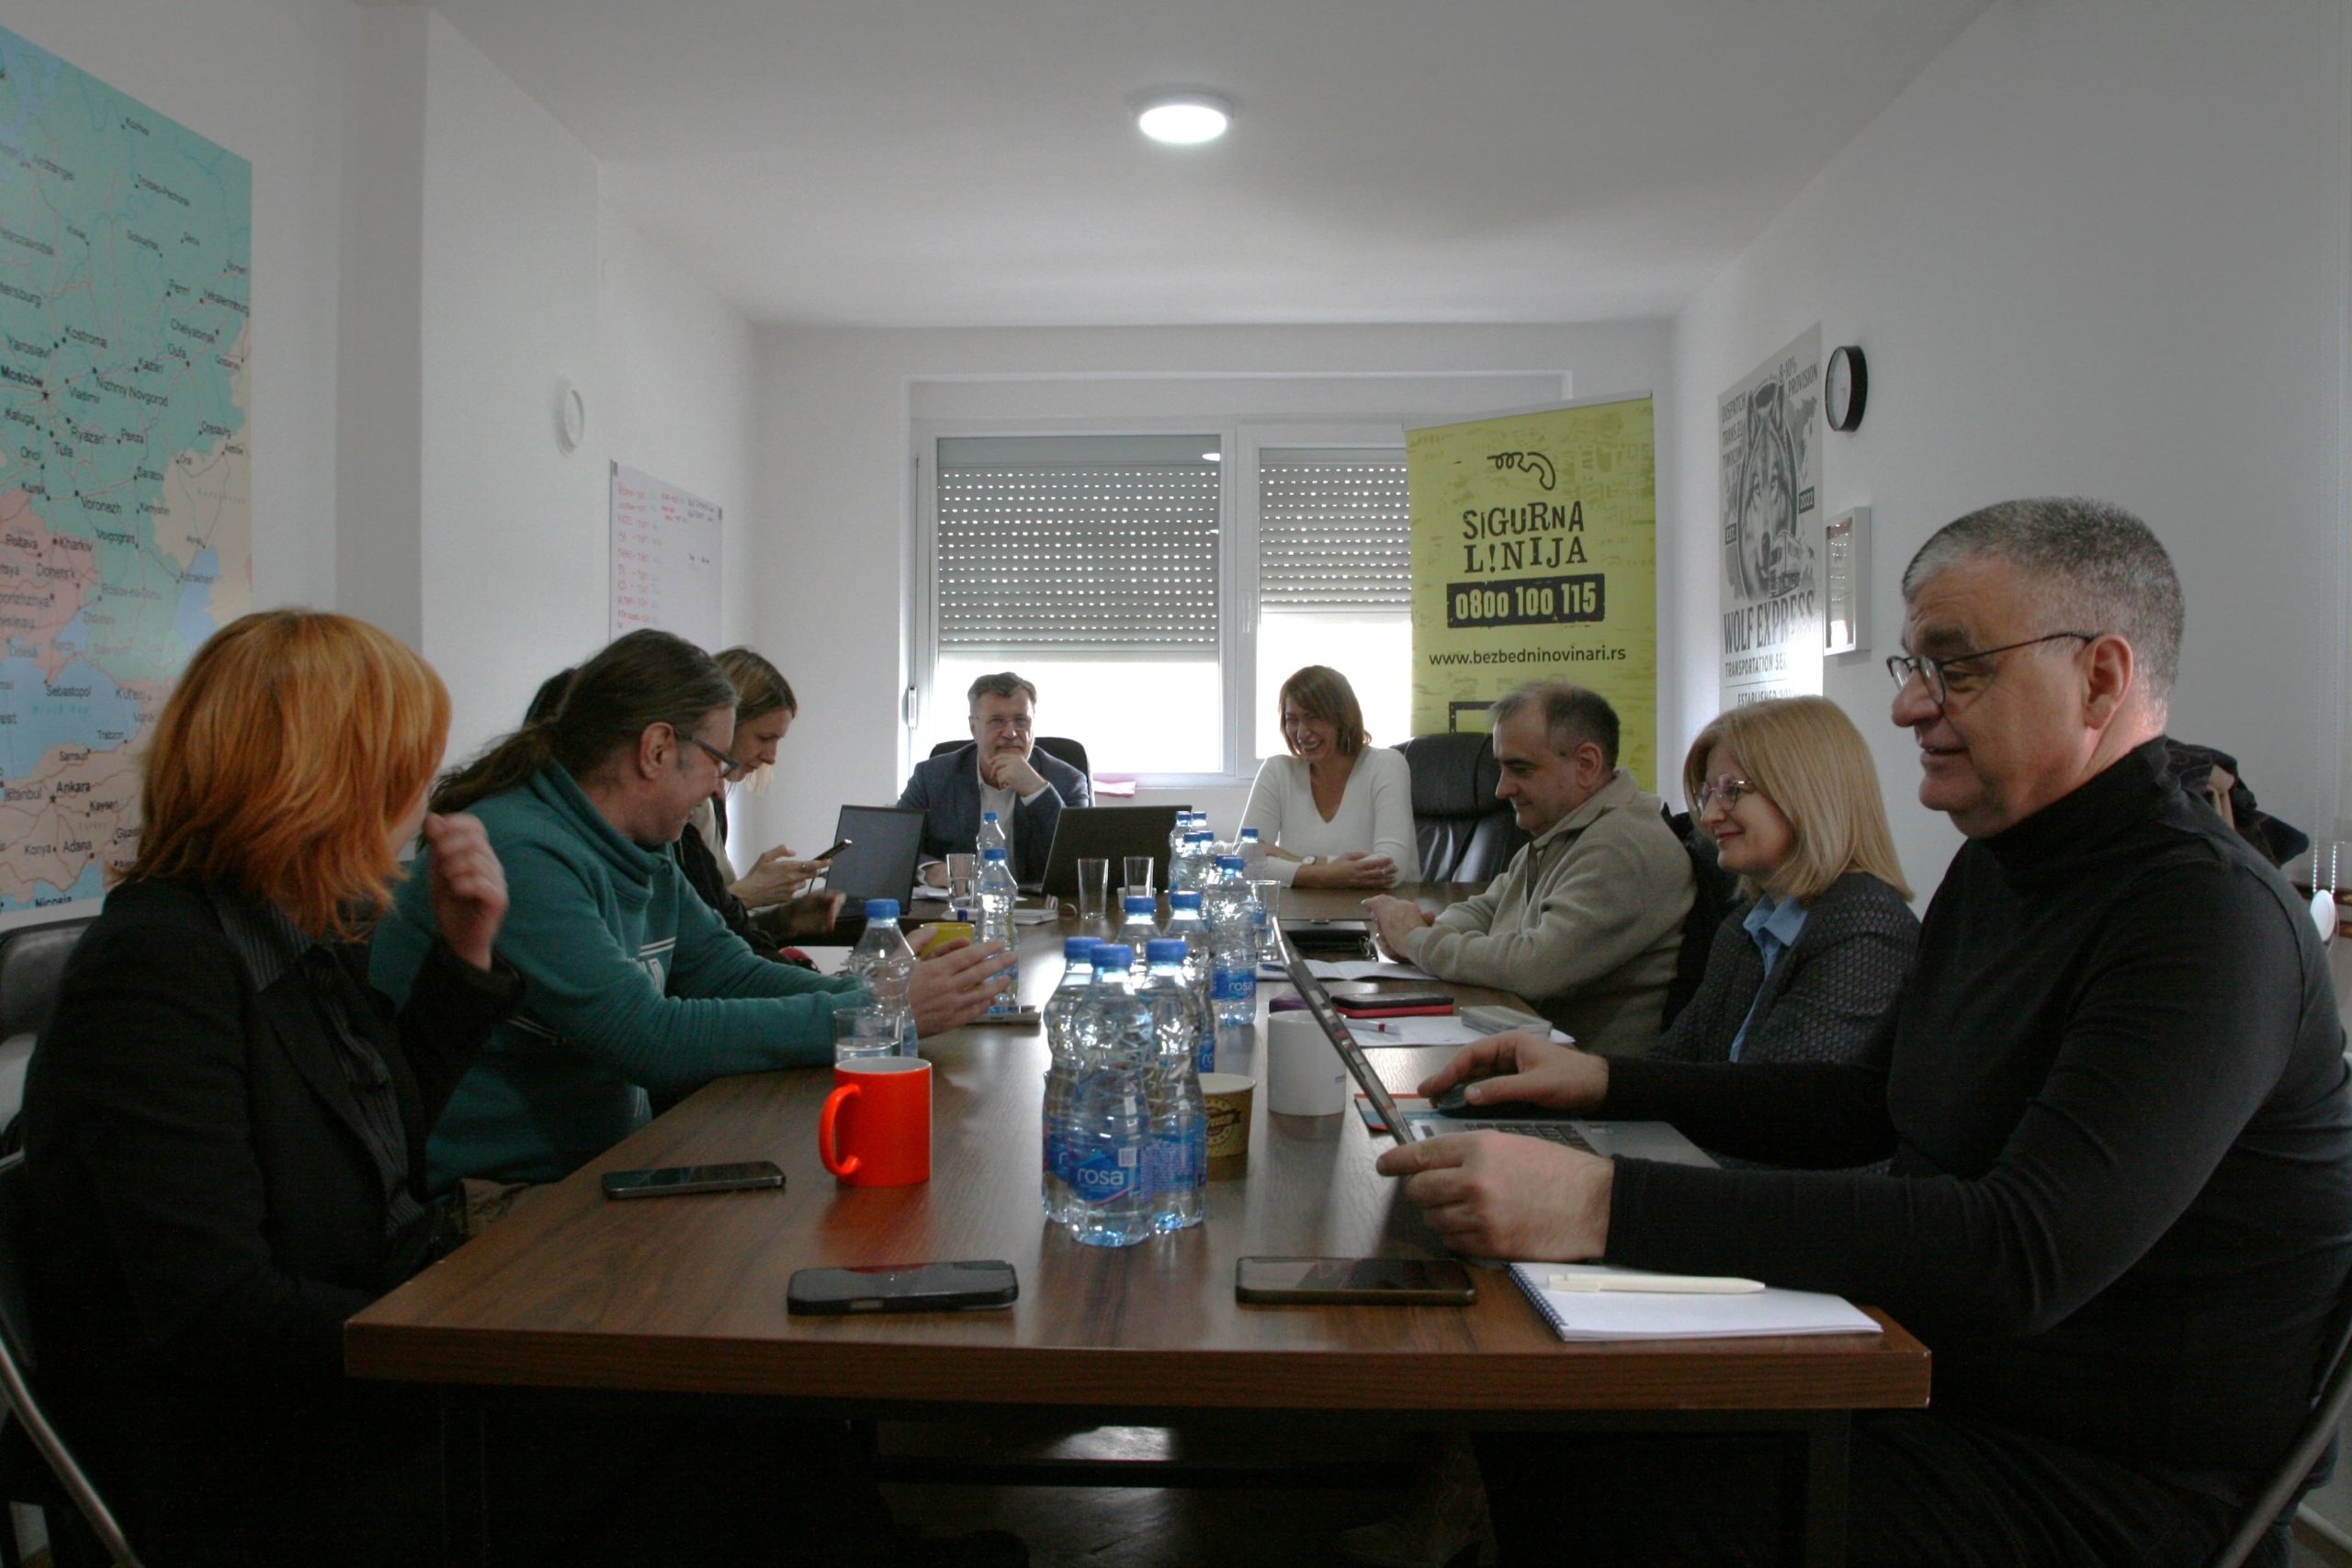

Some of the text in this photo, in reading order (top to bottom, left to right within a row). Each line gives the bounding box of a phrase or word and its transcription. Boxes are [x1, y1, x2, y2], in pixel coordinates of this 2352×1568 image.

[65, 323, 107, 349] Kostroma
[0, 364, 44, 388] Moscow
[1788, 362, 1818, 398] PROVISION
[129, 385, 169, 407] Novgorod
[1722, 390, 1747, 423] DISPATCH
[5, 407, 36, 426] Kaluga
[120, 427, 144, 445] Penza
[53, 441, 74, 457] Tula
[137, 465, 164, 482] Saratov
[20, 480, 46, 495] Kursk
[80, 496, 123, 515] Voronezh
[1800, 492, 1814, 510] 2022
[1462, 500, 1585, 540] SIGURNA
[6, 533, 39, 550] Poltava
[59, 536, 93, 553] Kharkiv
[96, 528, 135, 546] Volgograd
[1463, 536, 1589, 574] L!NIJA
[1455, 581, 1597, 621] 0800 100 115
[1724, 589, 1815, 655] WOLF EXPRESS
[1428, 644, 1627, 666] www.bezbedninovinari.rs
[1724, 653, 1774, 678] TRANSPORTATION
[46, 685, 92, 699] Sebastopol
[96, 729, 125, 740] Trabzon
[59, 750, 89, 762] Samsun
[4, 786, 42, 803] Istanbul
[56, 780, 92, 794] Ankara
[24, 843, 51, 857] Konya
[62, 840, 93, 853] Adana
[1228, 981, 1254, 992] rosa
[1077, 1168, 1125, 1186] rosa
